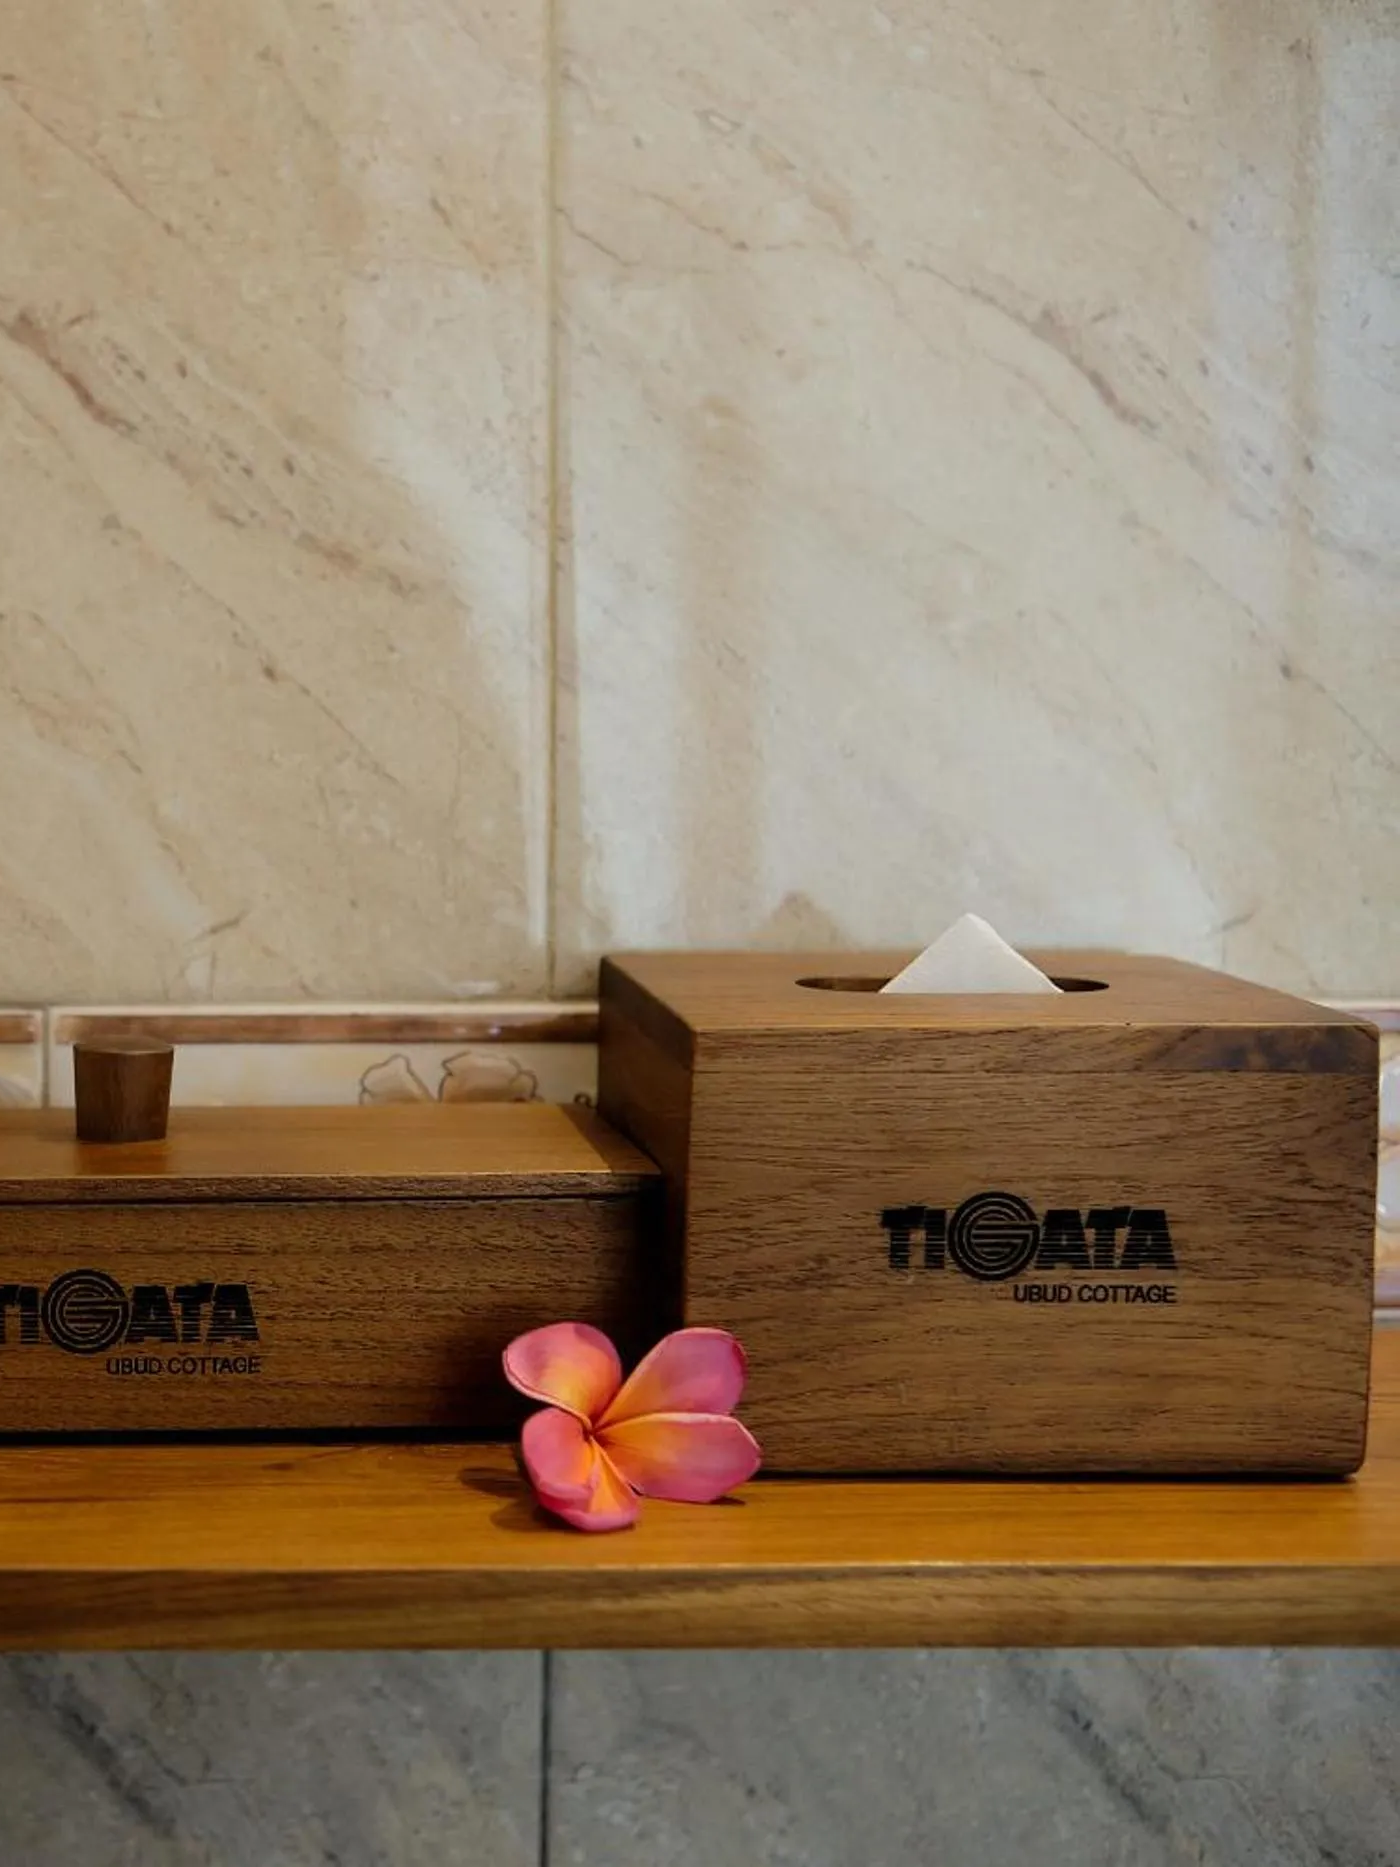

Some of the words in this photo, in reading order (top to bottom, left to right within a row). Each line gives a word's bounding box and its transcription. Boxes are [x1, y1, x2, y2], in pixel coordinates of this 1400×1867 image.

[879, 1191, 1178, 1281] TIGATA
[1013, 1285, 1072, 1303] UBUD
[1077, 1285, 1177, 1304] COTTAGE
[106, 1357, 163, 1375] UBUD
[169, 1356, 260, 1375] COTTAGE
